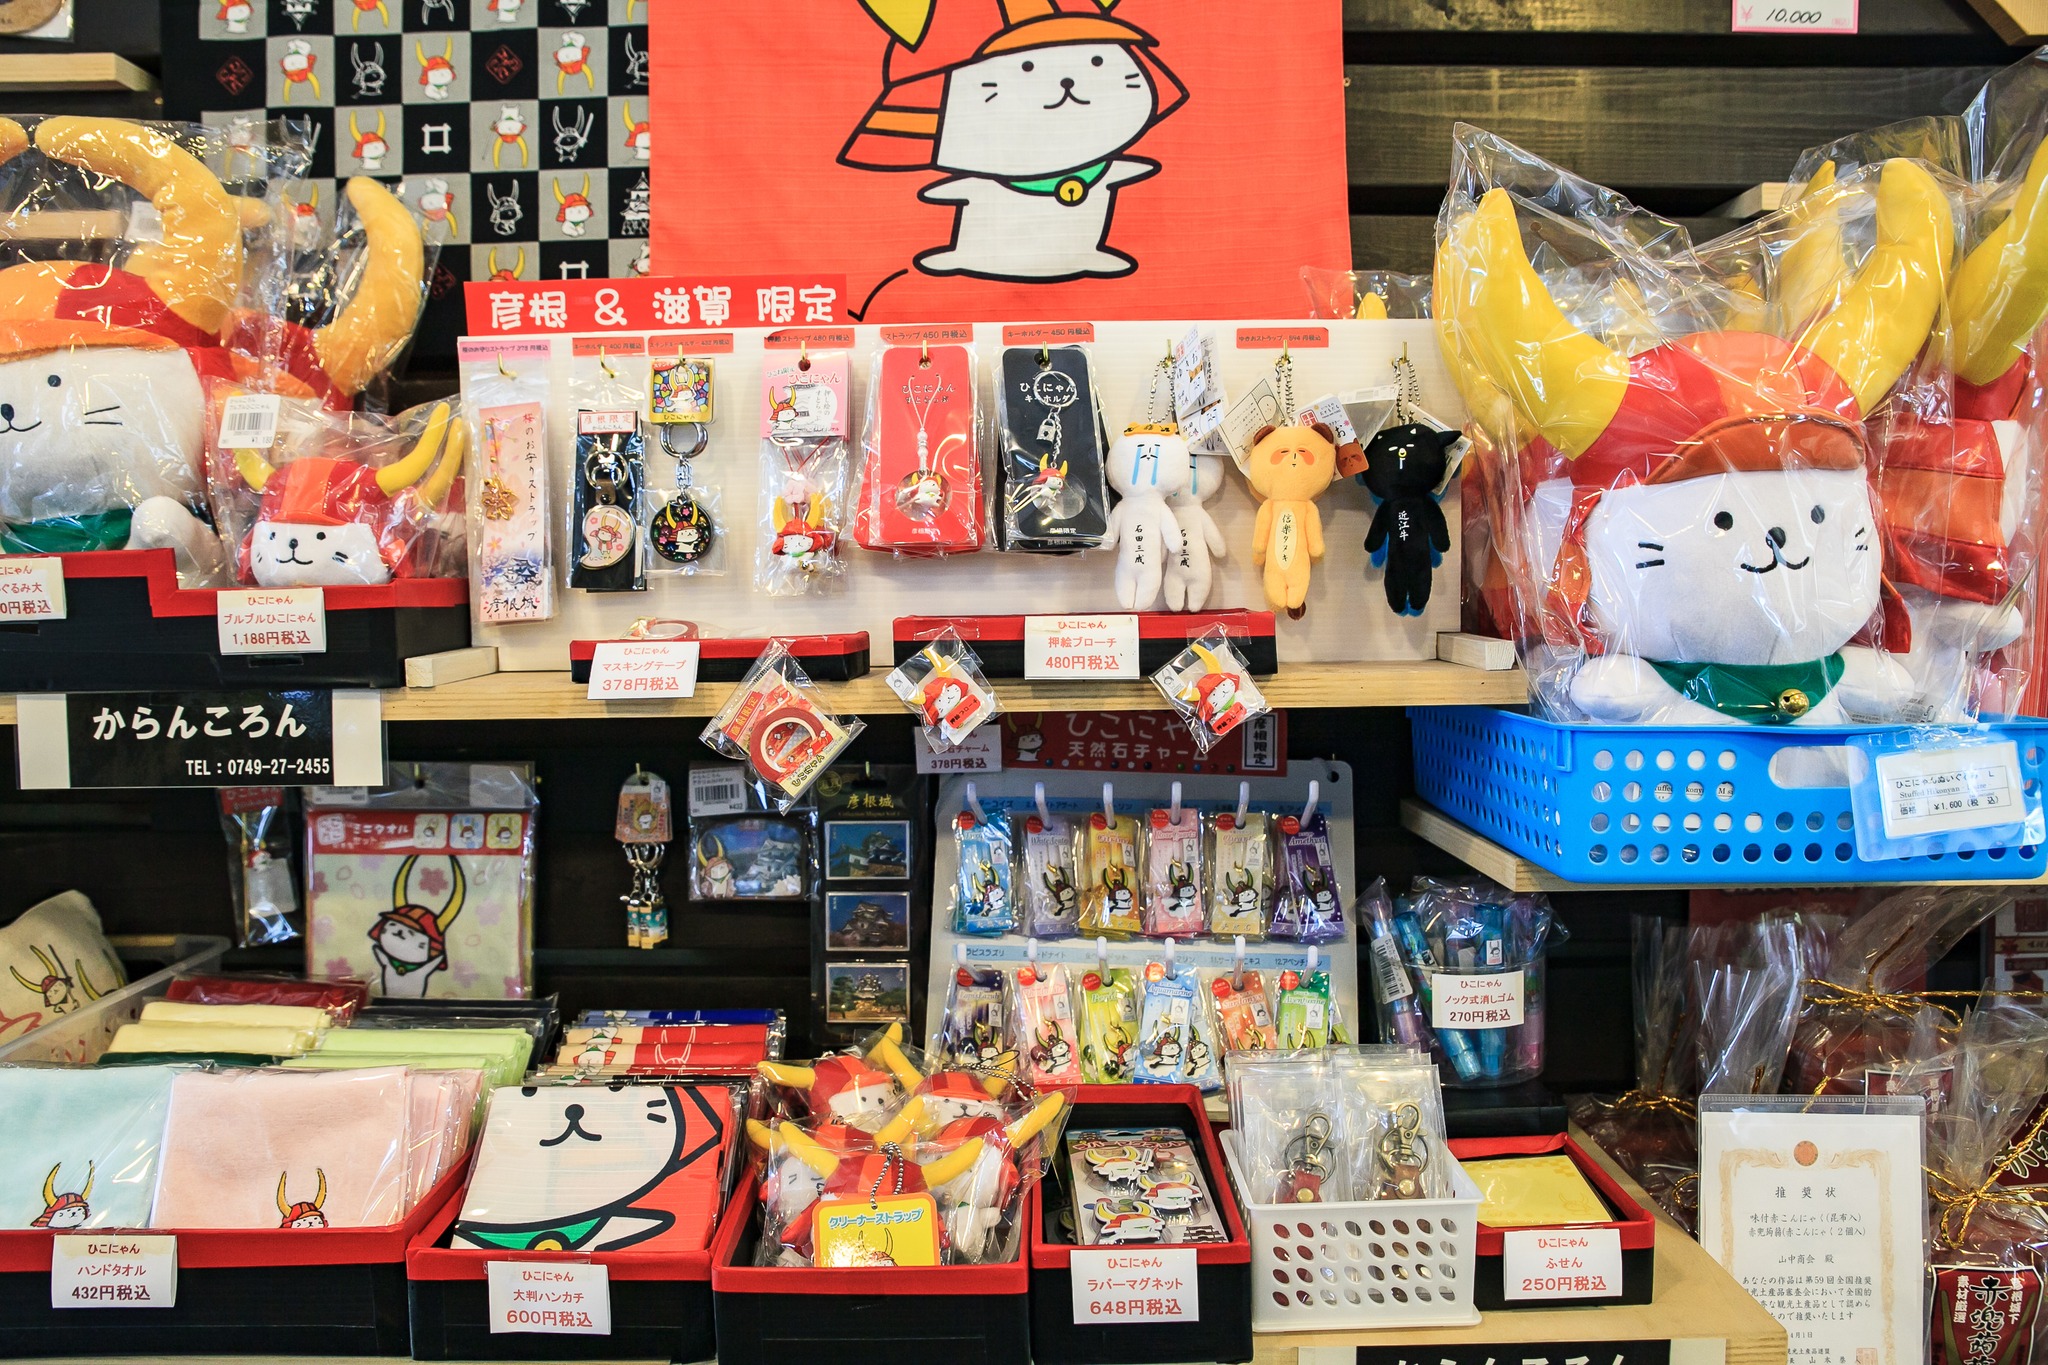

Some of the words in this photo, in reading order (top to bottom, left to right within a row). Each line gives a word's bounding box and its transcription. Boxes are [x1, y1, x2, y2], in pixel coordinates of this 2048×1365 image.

[490, 290, 568, 330] 彦根
[594, 288, 628, 326] &
[652, 285, 732, 326] 滋賀
[756, 284, 838, 323] 限定
[923, 330, 939, 339] 450
[941, 330, 968, 339] 円税込
[1051, 328, 1066, 336] 450
[788, 372, 841, 385] ひこにゃん
[1397, 510, 1410, 541] 近江牛
[1134, 524, 1145, 566] 石田三成
[0, 582, 43, 594] ぐるみ大
[247, 595, 294, 606] ひこにゃん
[223, 612, 317, 625] ブルブルひこにゃん
[1057, 620, 1107, 630] ひこにゃん
[232, 630, 311, 646] 1,188円税込
[1047, 636, 1118, 650] 押絵ブローチ
[623, 645, 670, 656] ひこにゃん
[602, 660, 687, 673] マスキングテープ
[1045, 655, 1120, 671] 480円税込
[602, 677, 680, 692] 378円税込
[93, 703, 307, 741] からんころん
[1065, 712, 1190, 741] ひこにゃ
[1252, 717, 1268, 766] 彦根限定
[930, 757, 988, 769] 378円税込
[846, 792, 895, 810] 彦根城
[352, 823, 410, 835] ミニタオル
[1460, 979, 1502, 989] ひこにゃん
[1445, 993, 1515, 1006] ノック式消しゴム
[1449, 1009, 1511, 1023] 270円税込
[828, 1208, 924, 1229] クリーナーストラップ
[87, 1242, 140, 1255] ひこにゃん
[1537, 1237, 1589, 1249] ひこにゃん
[1107, 1256, 1163, 1269] ひこにゃん
[1545, 1256, 1583, 1270] ふせん
[77, 1263, 146, 1277] ハンドタオル
[522, 1269, 574, 1283] ひこにゃん
[1086, 1277, 1184, 1292] ラバーマグネット
[1521, 1274, 1607, 1293] 250円税込
[71, 1285, 151, 1302] 432円税込
[512, 1288, 585, 1304] 大判ハンカチ
[1089, 1298, 1183, 1317] 648円税込
[506, 1309, 593, 1329] 600円税込
